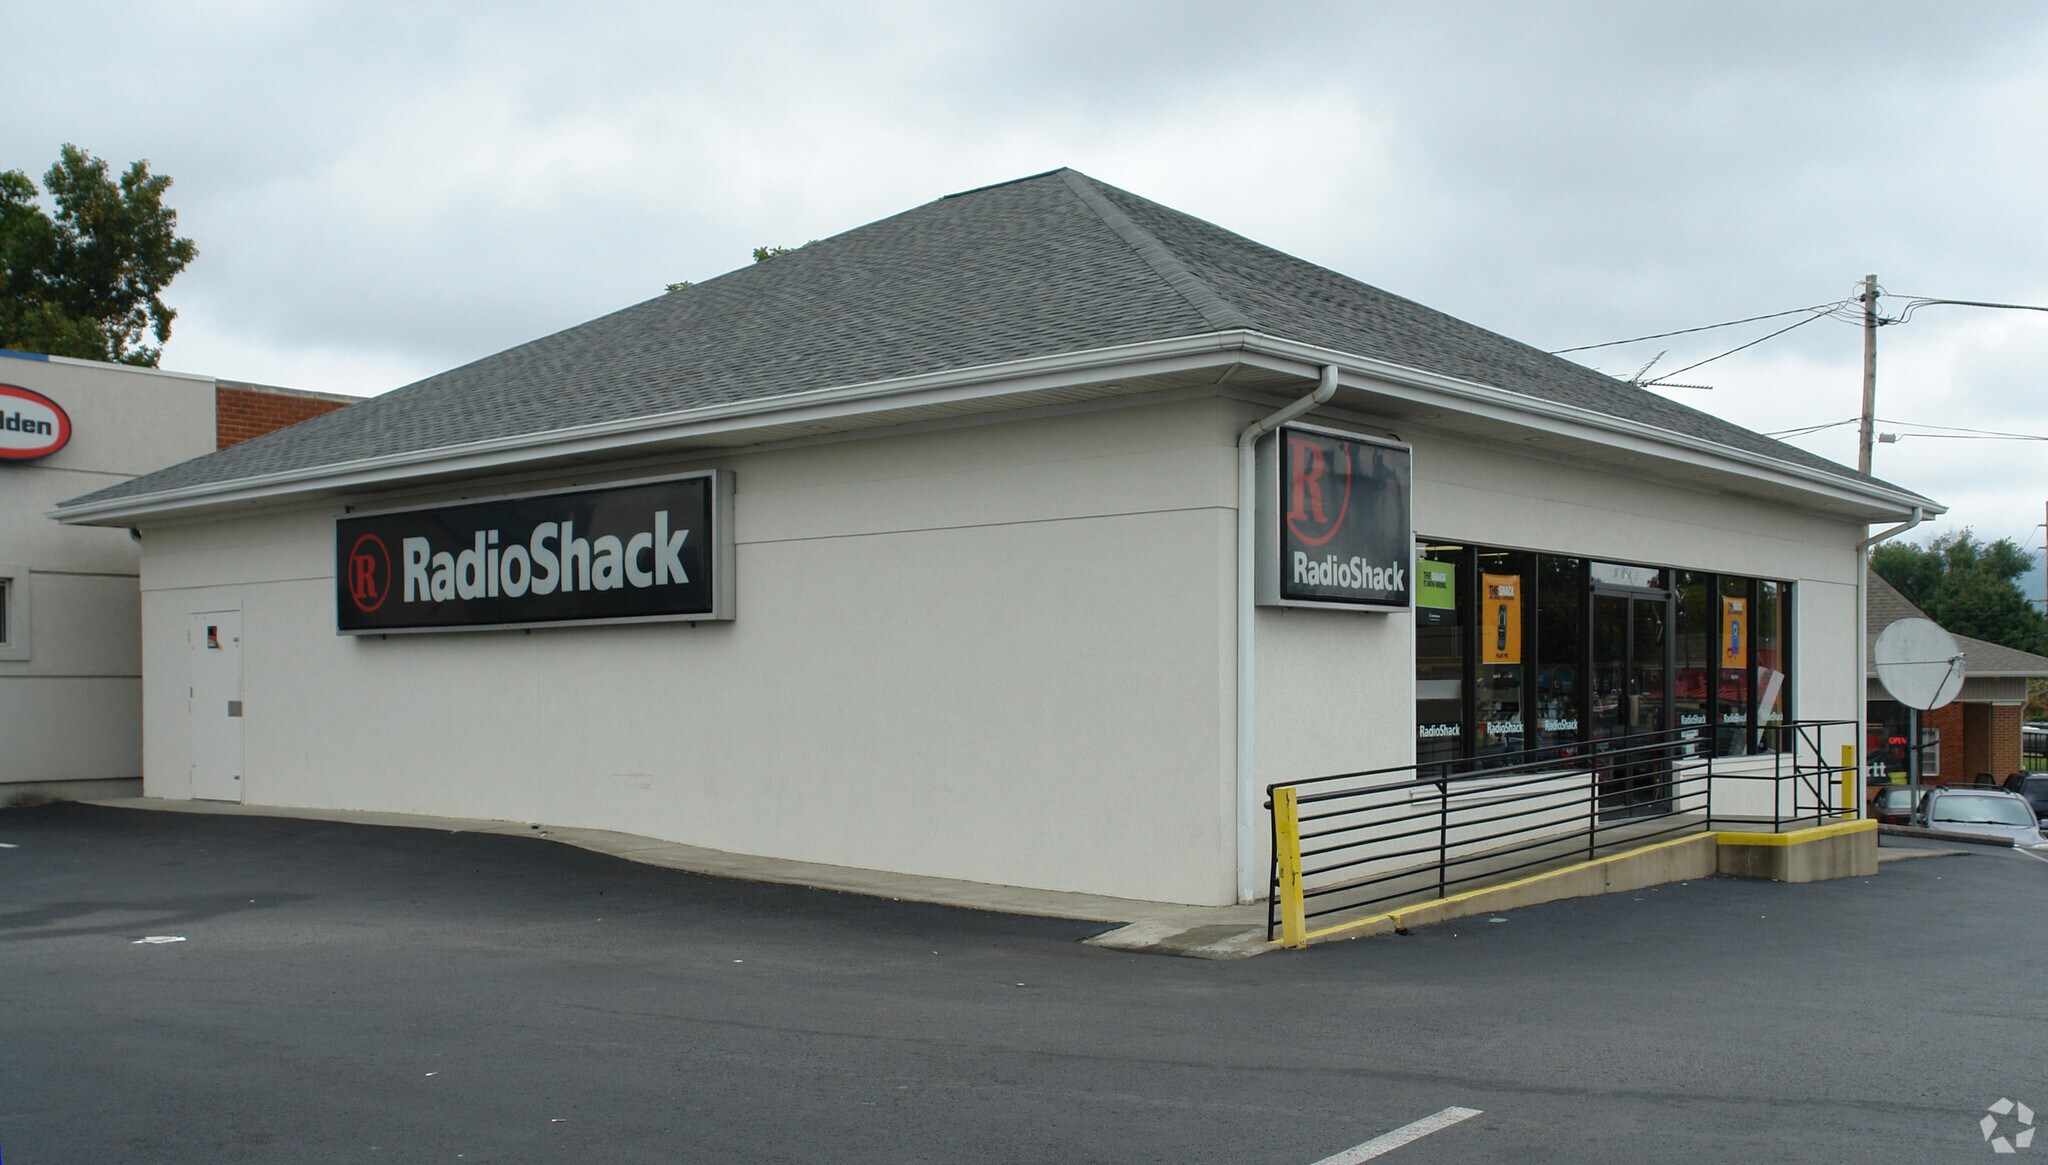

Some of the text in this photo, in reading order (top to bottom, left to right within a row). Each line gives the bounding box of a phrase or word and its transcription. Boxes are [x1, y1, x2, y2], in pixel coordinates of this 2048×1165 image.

[402, 510, 690, 603] RadioShack
[1294, 550, 1405, 592] RadioShack
[1489, 585, 1499, 596] THE
[1419, 723, 1461, 738] RadioShack
[1486, 720, 1524, 735] RadioShack
[1544, 718, 1579, 732] RadioShack
[1888, 736, 1908, 745] OPEN
